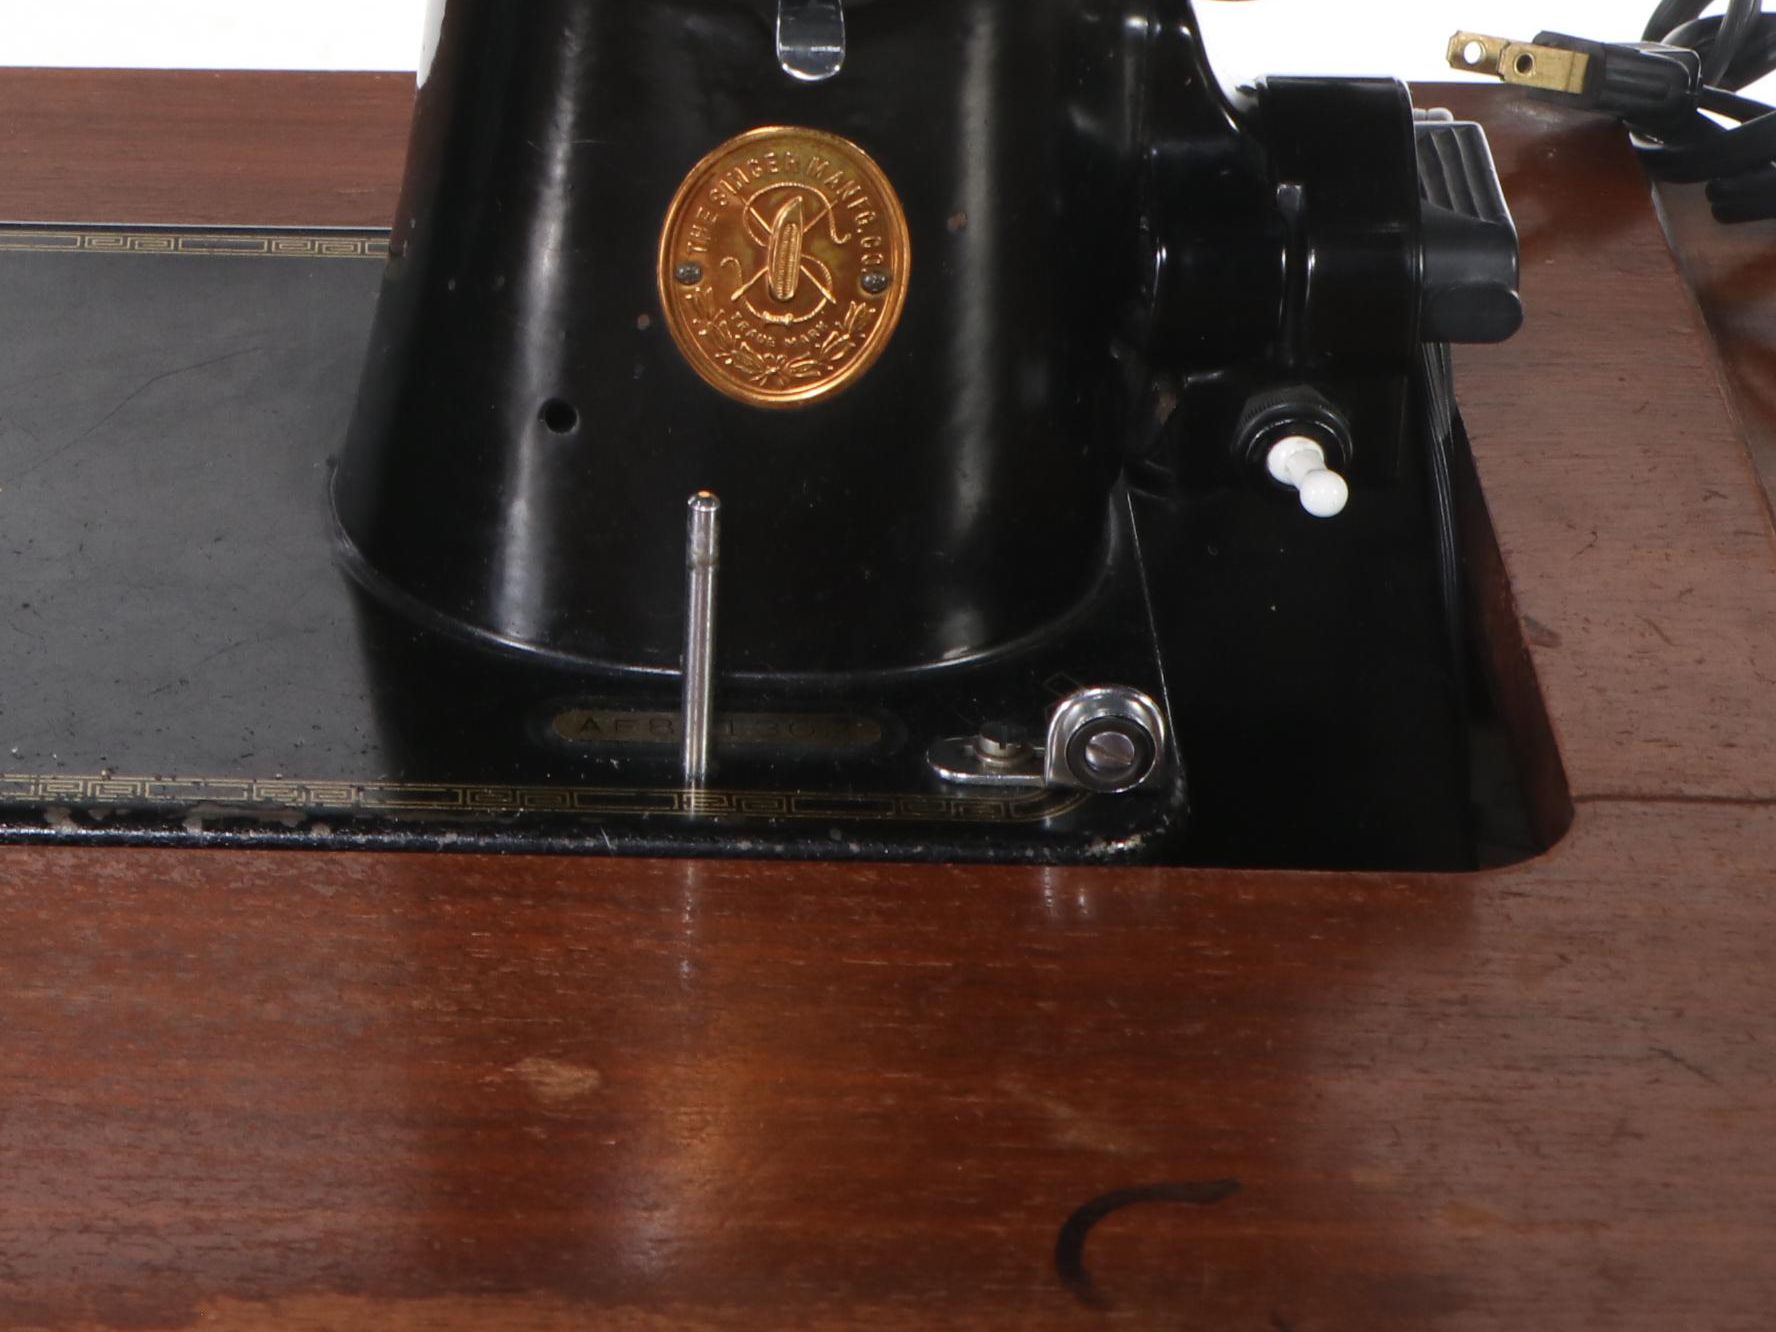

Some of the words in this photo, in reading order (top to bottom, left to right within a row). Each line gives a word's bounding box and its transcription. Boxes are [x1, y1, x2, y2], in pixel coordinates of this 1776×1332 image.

[687, 205, 720, 254] THE
[709, 151, 801, 206] SINGER
[731, 311, 776, 348] TRADE
[784, 320, 829, 345] MARK
